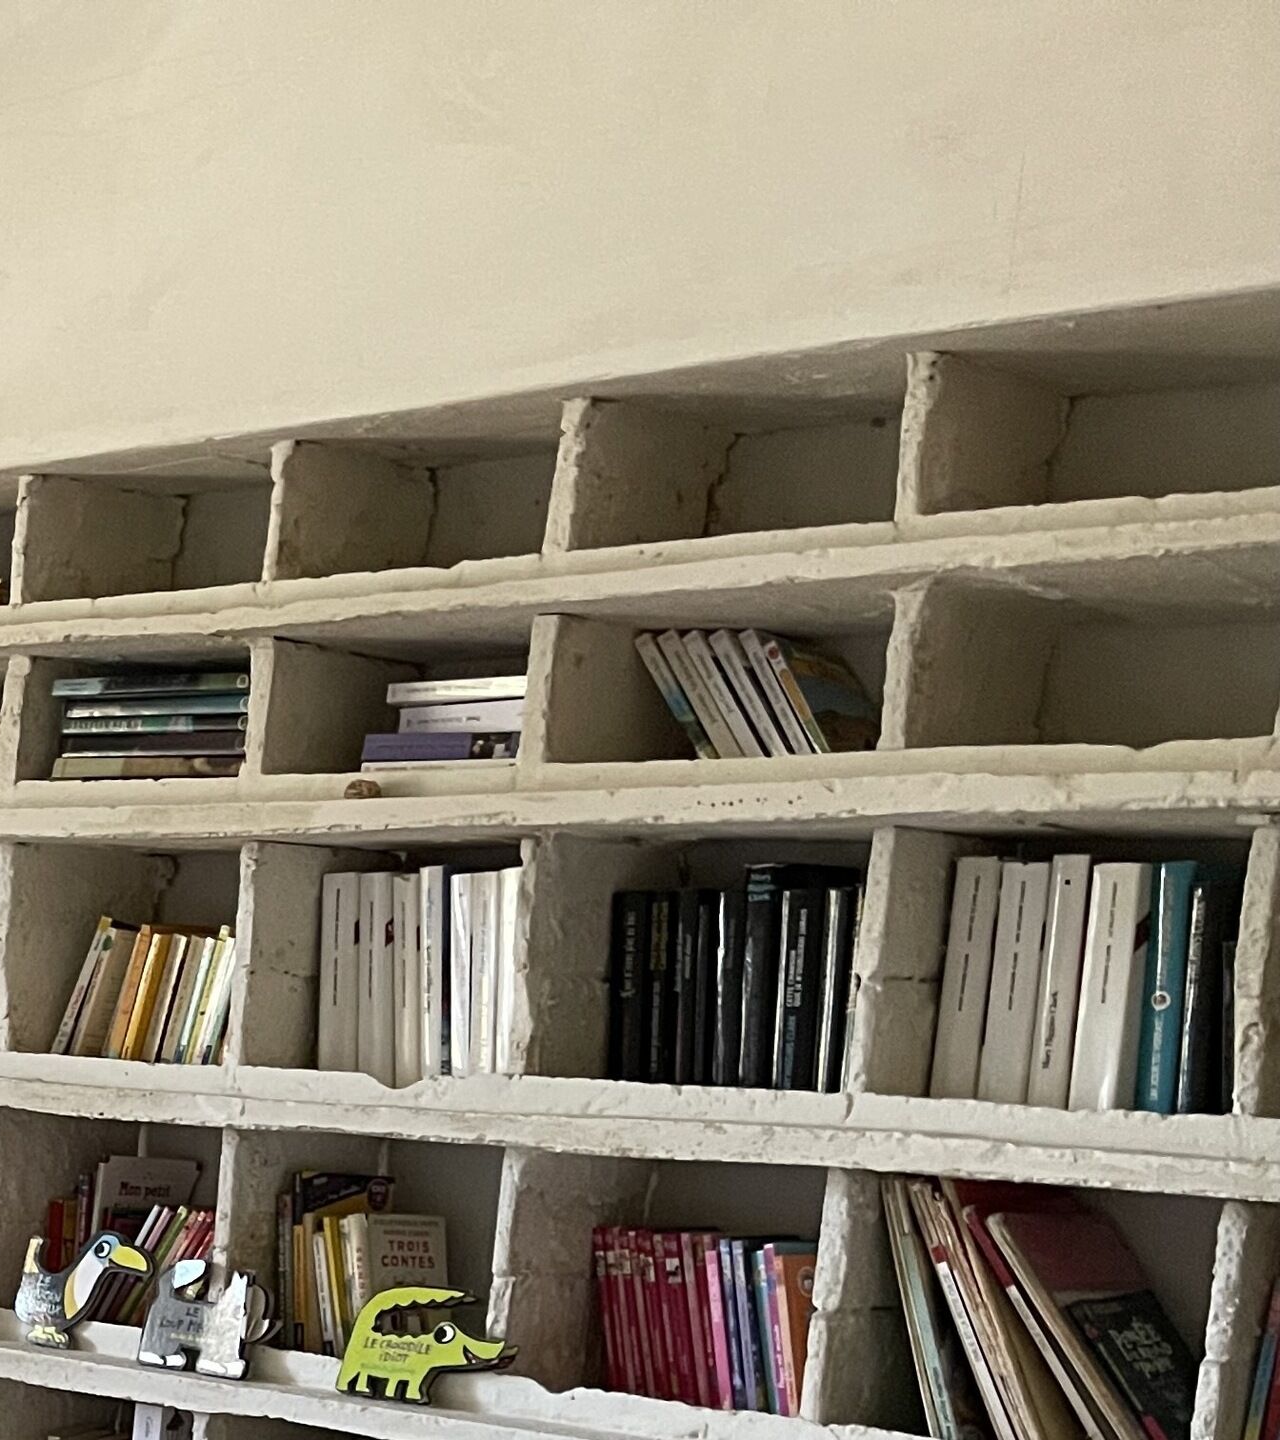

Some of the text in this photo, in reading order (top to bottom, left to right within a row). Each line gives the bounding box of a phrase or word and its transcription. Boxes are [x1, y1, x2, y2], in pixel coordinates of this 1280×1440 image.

[120, 1182, 171, 1200] Mon petit
[388, 1240, 430, 1254] TROIS
[381, 1255, 436, 1269] CONTES
[186, 1307, 200, 1318] LE
[364, 1336, 380, 1349] LE
